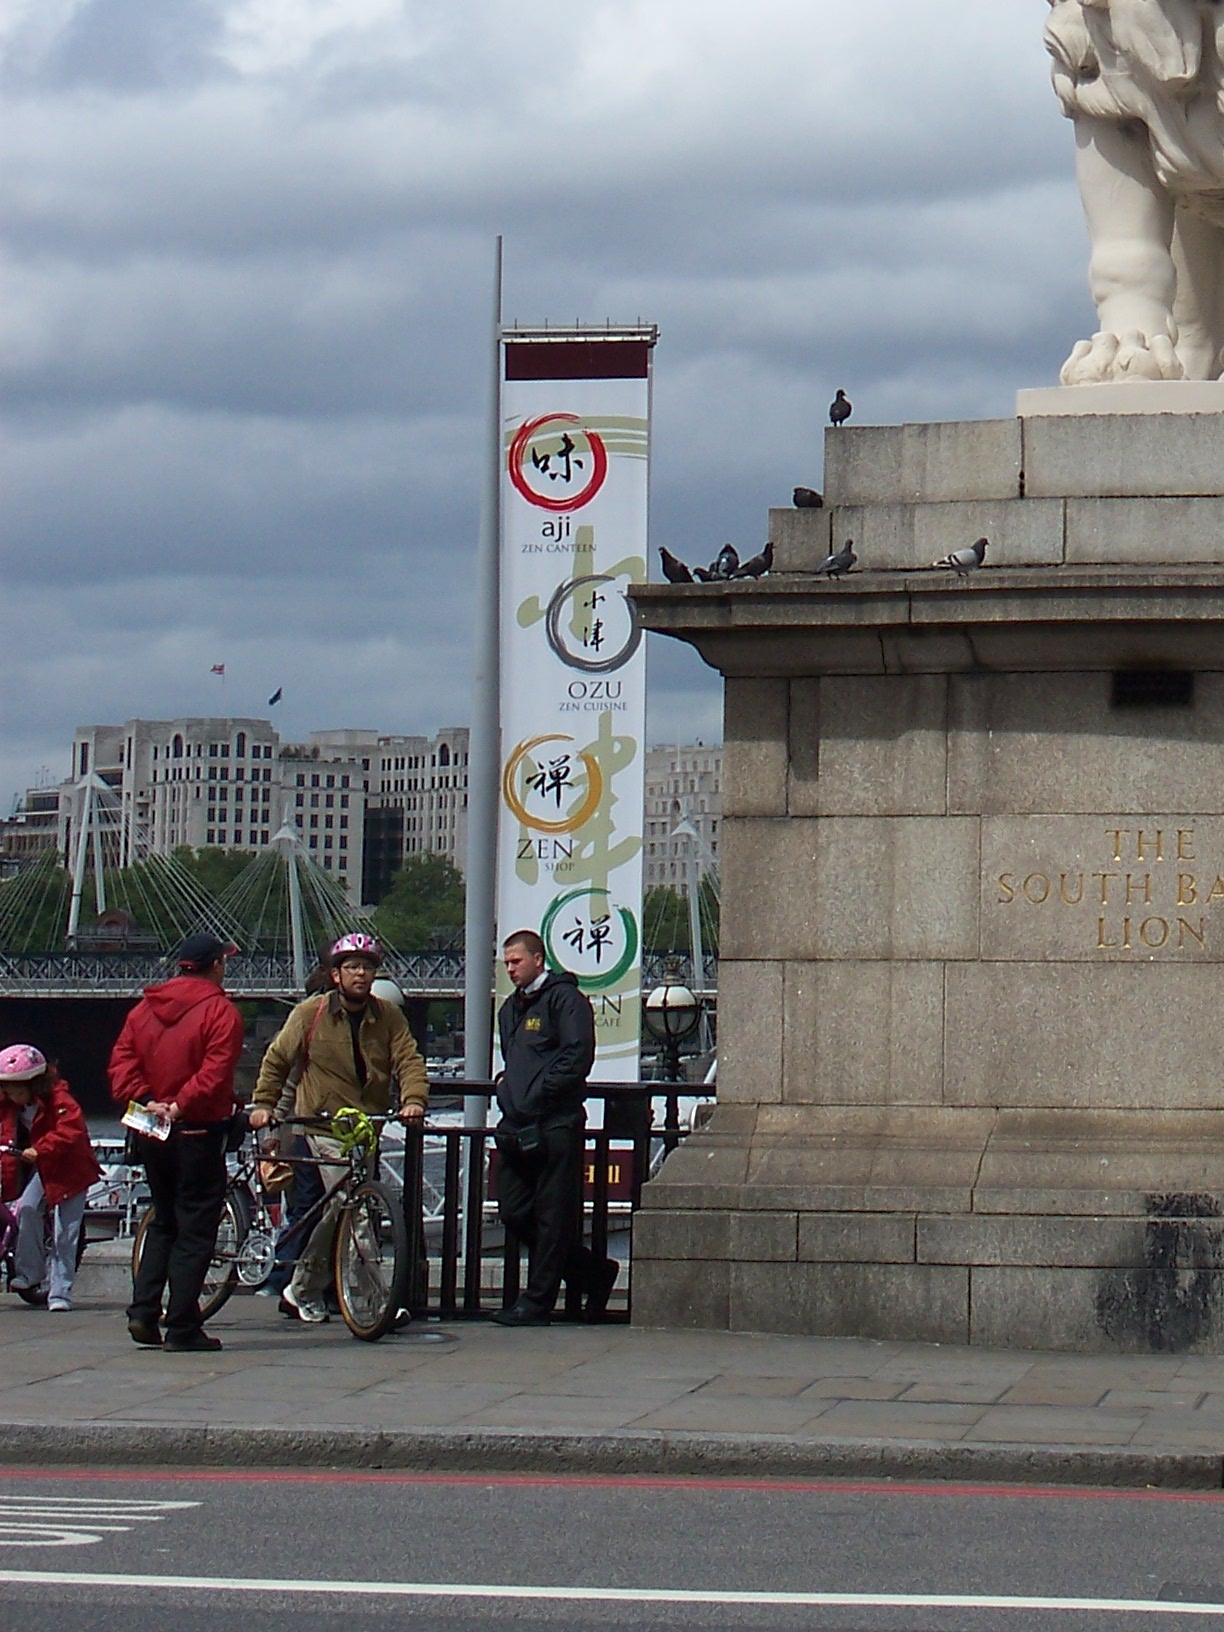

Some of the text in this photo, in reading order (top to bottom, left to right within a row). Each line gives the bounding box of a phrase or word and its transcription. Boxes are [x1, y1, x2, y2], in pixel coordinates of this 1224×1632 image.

[532, 433, 583, 483] 味
[541, 516, 571, 543] aji
[521, 544, 597, 553] ZEN CANTEEN
[568, 680, 622, 700] OZU
[559, 701, 628, 711] ZEN CUISINE
[517, 838, 573, 860] ZEN
[1105, 829, 1196, 862] THE
[545, 862, 575, 872] SHOP
[997, 872, 1152, 906] SOUTH
[1096, 916, 1207, 950] LION
